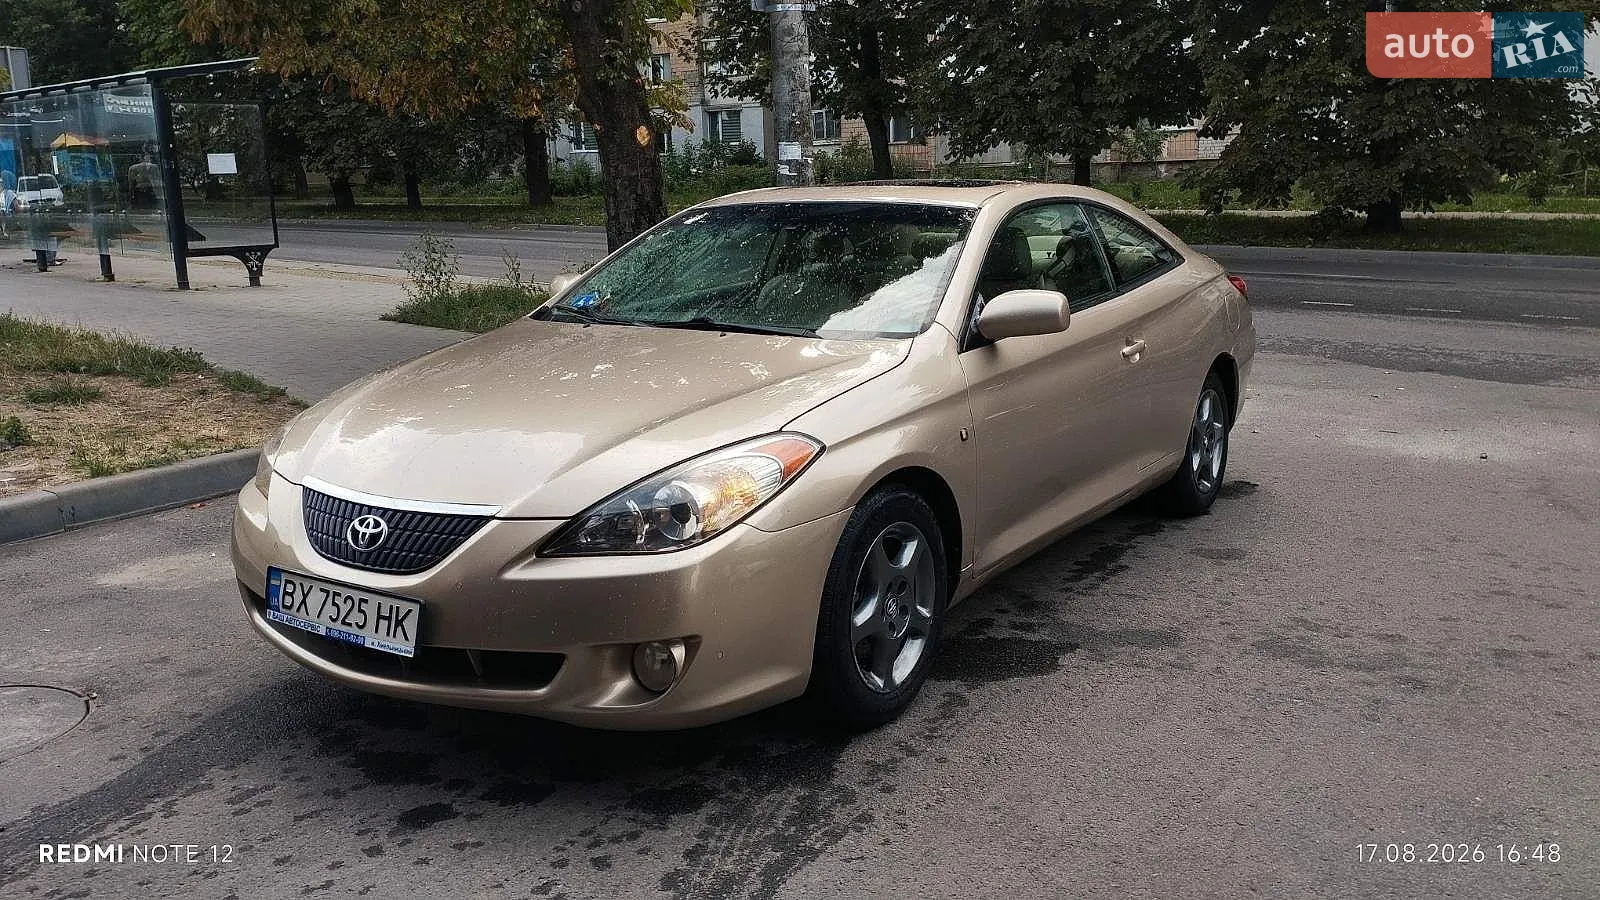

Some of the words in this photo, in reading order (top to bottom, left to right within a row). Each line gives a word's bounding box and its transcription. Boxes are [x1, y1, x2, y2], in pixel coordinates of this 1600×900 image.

[281, 578, 313, 616] BX
[317, 587, 369, 630] 7525
[374, 601, 413, 642] HK
